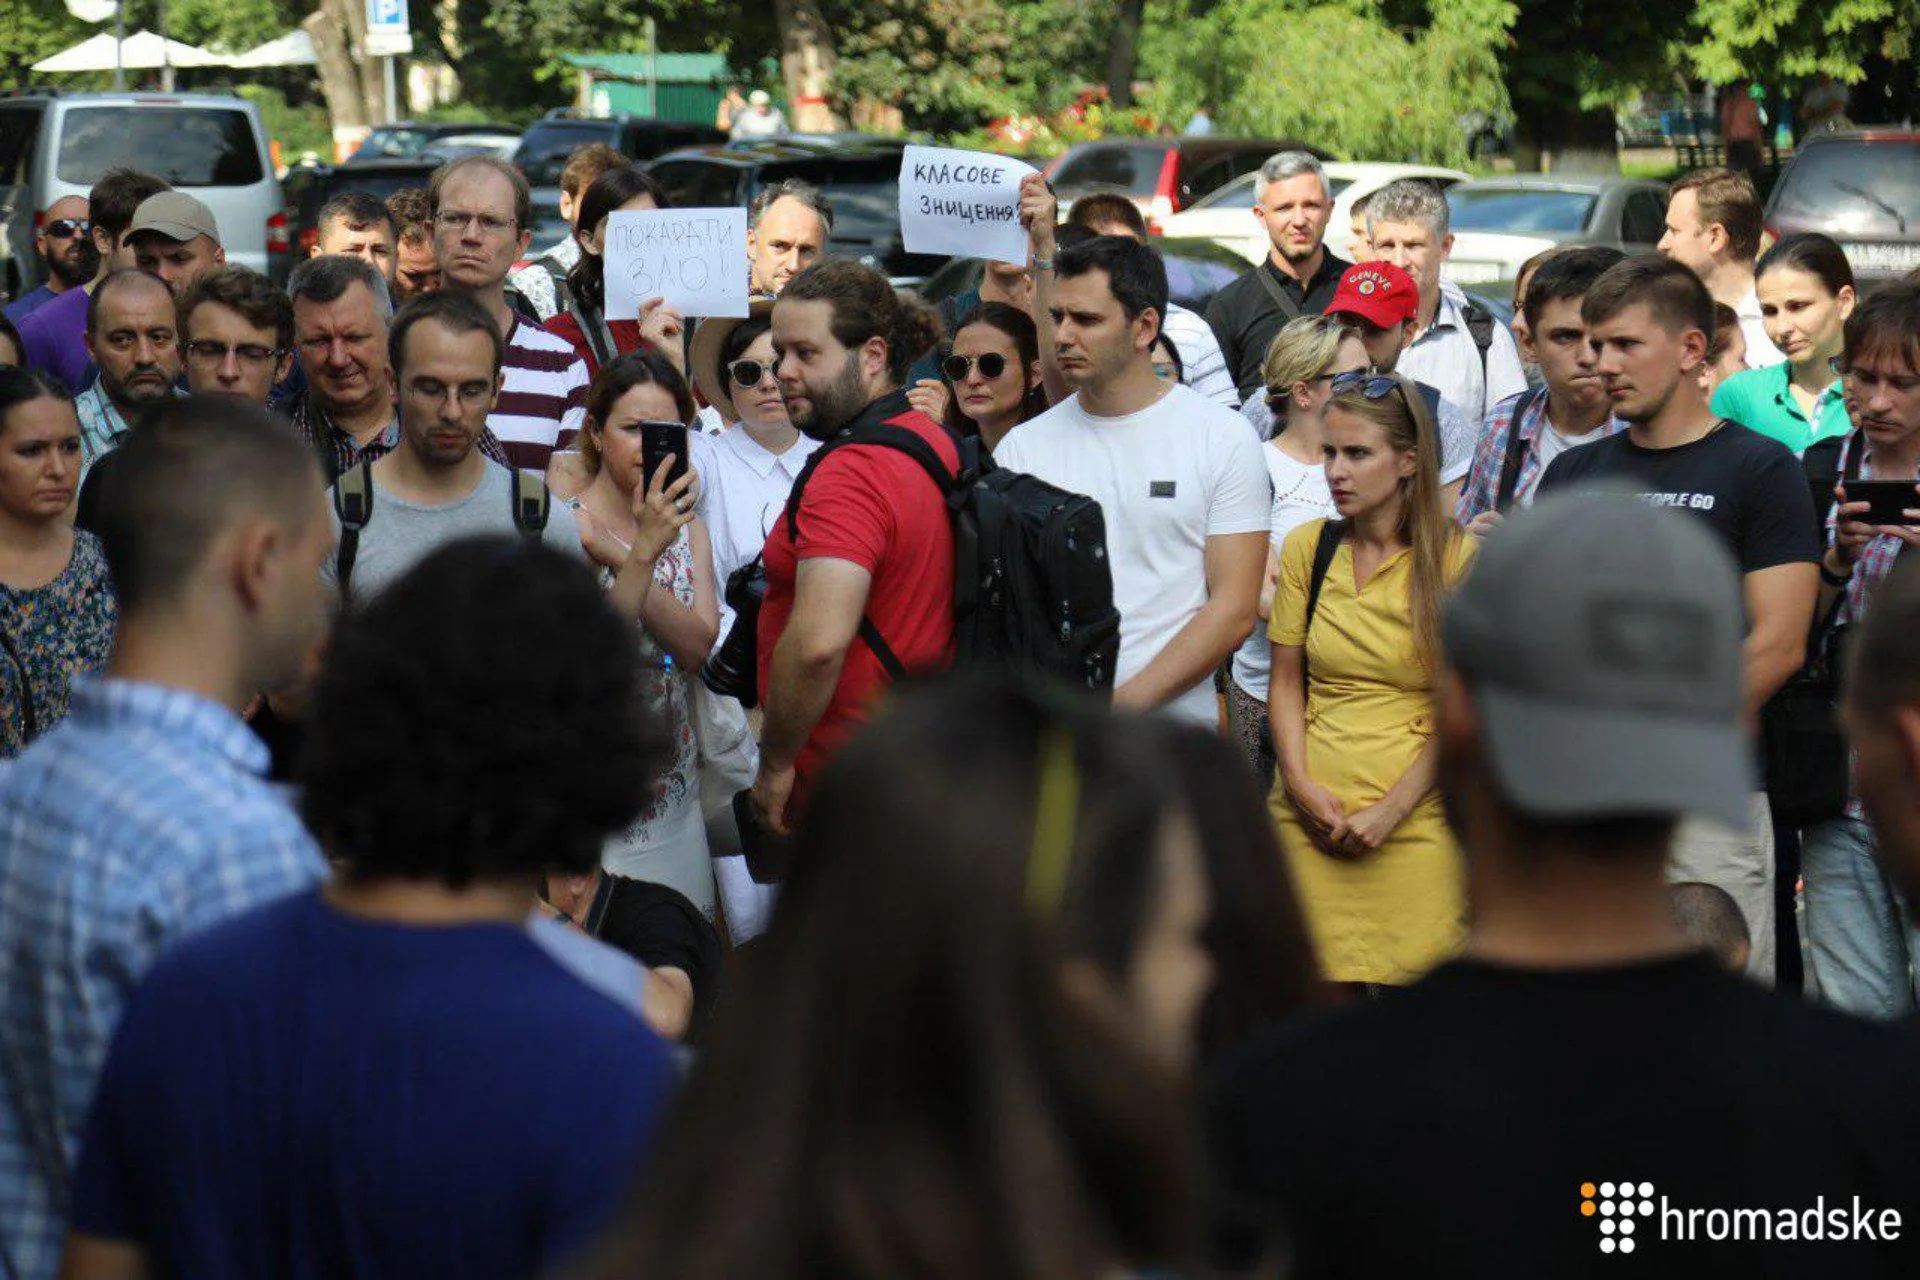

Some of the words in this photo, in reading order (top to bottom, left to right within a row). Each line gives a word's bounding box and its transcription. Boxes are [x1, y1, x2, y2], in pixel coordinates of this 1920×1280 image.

[914, 163, 1005, 184] КЛАСОВЕ
[615, 219, 733, 252] ПОКАРАТИ
[1636, 492, 1689, 507] EOPLE
[1690, 493, 1716, 510] GO
